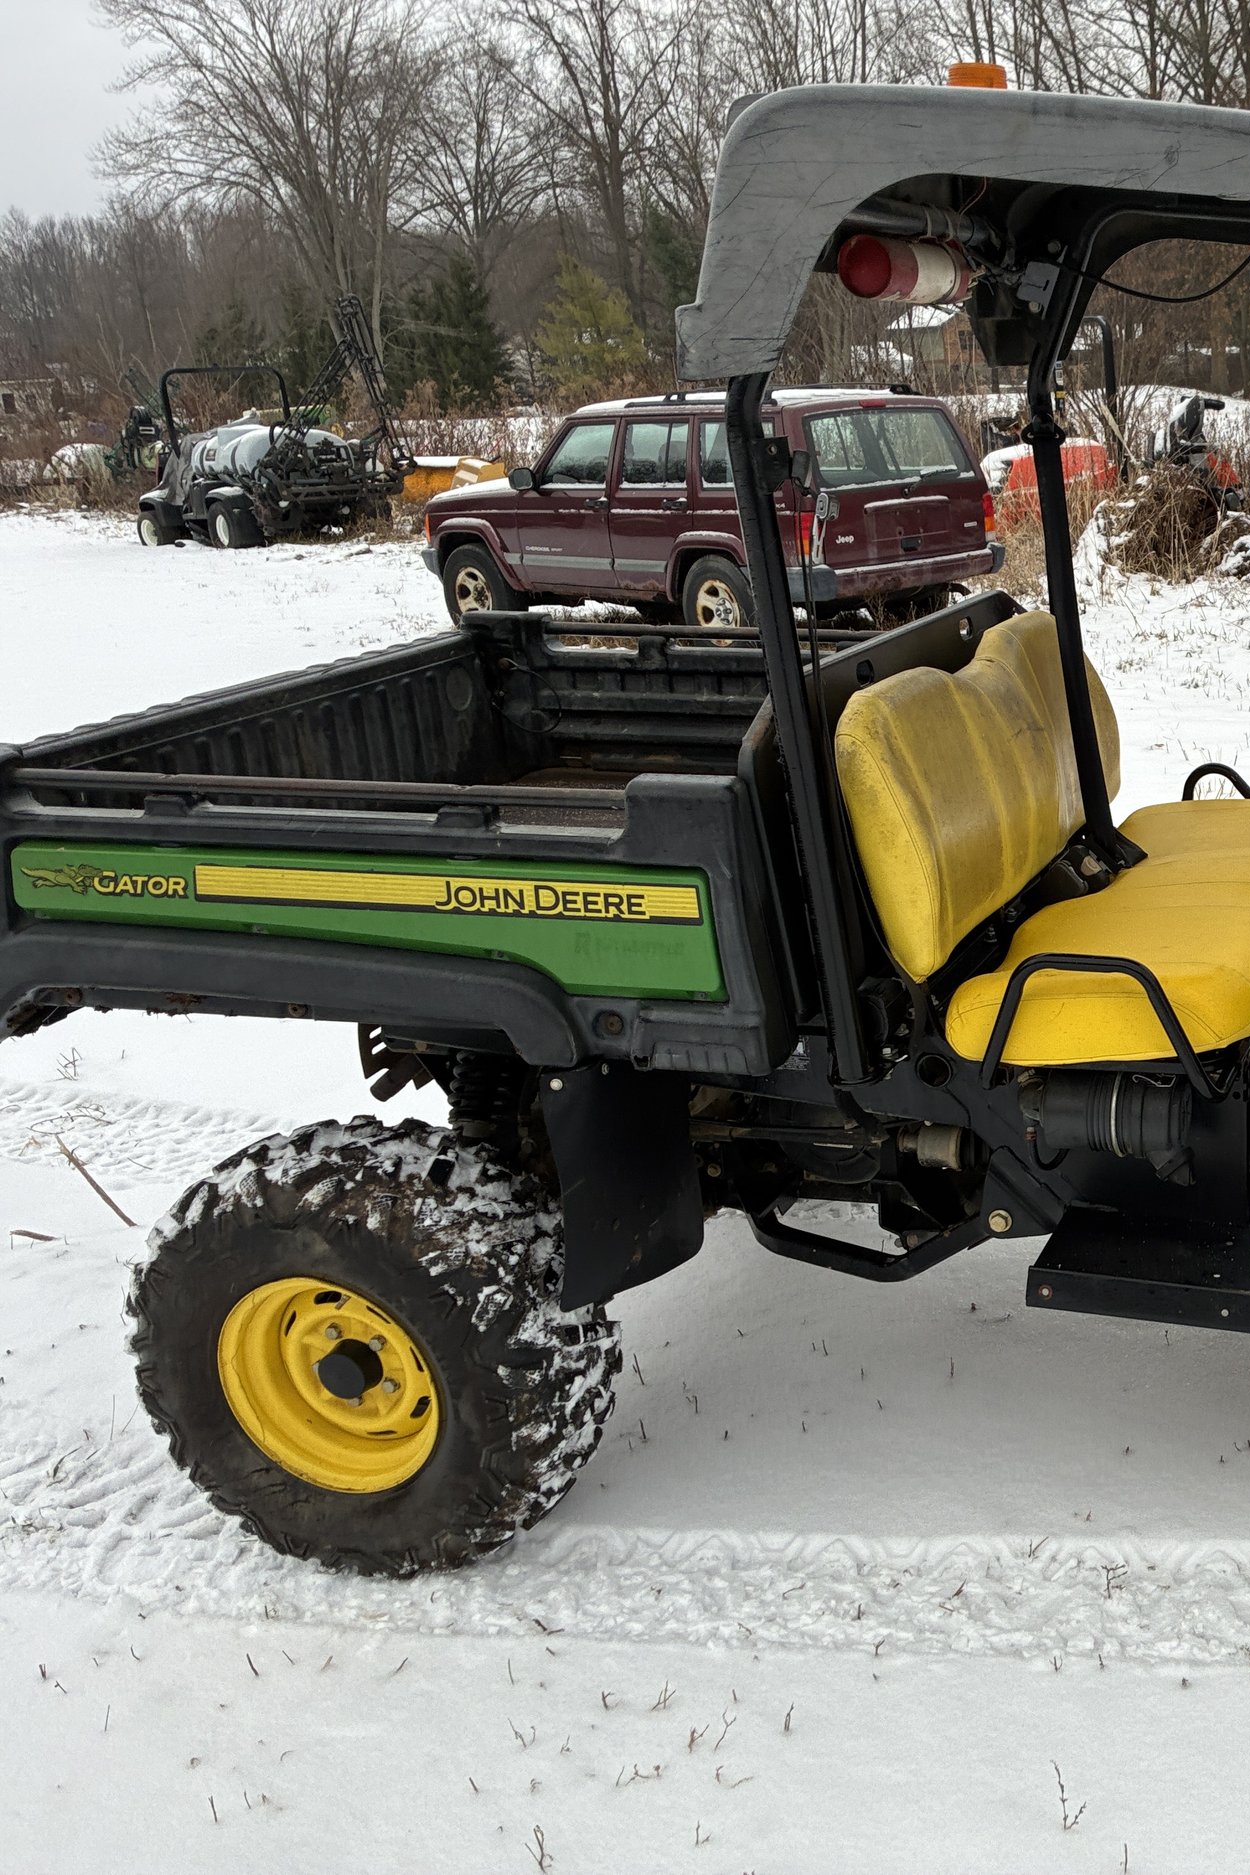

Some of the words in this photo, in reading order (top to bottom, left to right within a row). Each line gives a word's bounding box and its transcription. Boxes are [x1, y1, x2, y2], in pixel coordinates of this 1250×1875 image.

[835, 535, 855, 544] Jeep
[93, 870, 187, 898] GATOR
[434, 880, 525, 911] JOHN
[533, 884, 647, 916] DEERE
